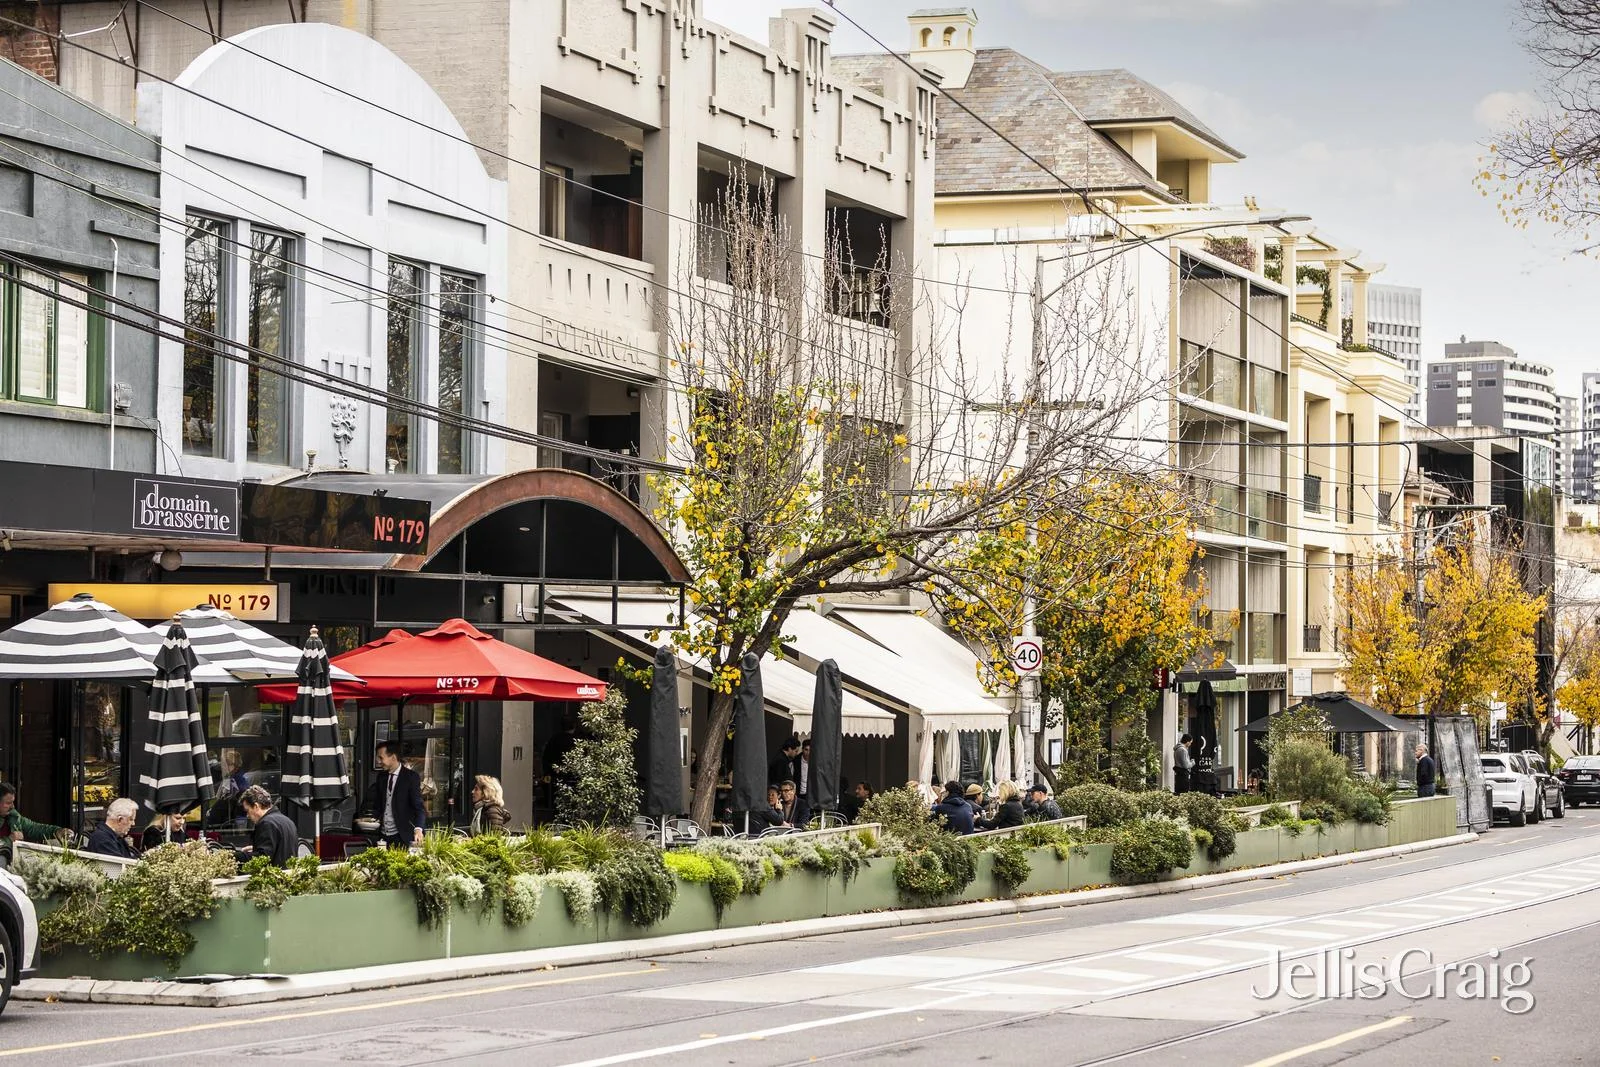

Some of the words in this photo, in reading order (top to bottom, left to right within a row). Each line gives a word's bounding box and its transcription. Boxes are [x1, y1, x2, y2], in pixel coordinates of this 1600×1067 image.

[542, 316, 647, 366] BOTANICAL
[145, 484, 210, 511] domain
[140, 499, 230, 532] brasserie
[398, 519, 425, 544] 179
[238, 595, 271, 611] 179
[1017, 649, 1038, 663] 40
[457, 677, 479, 688] 179
[512, 746, 523, 760] 171
